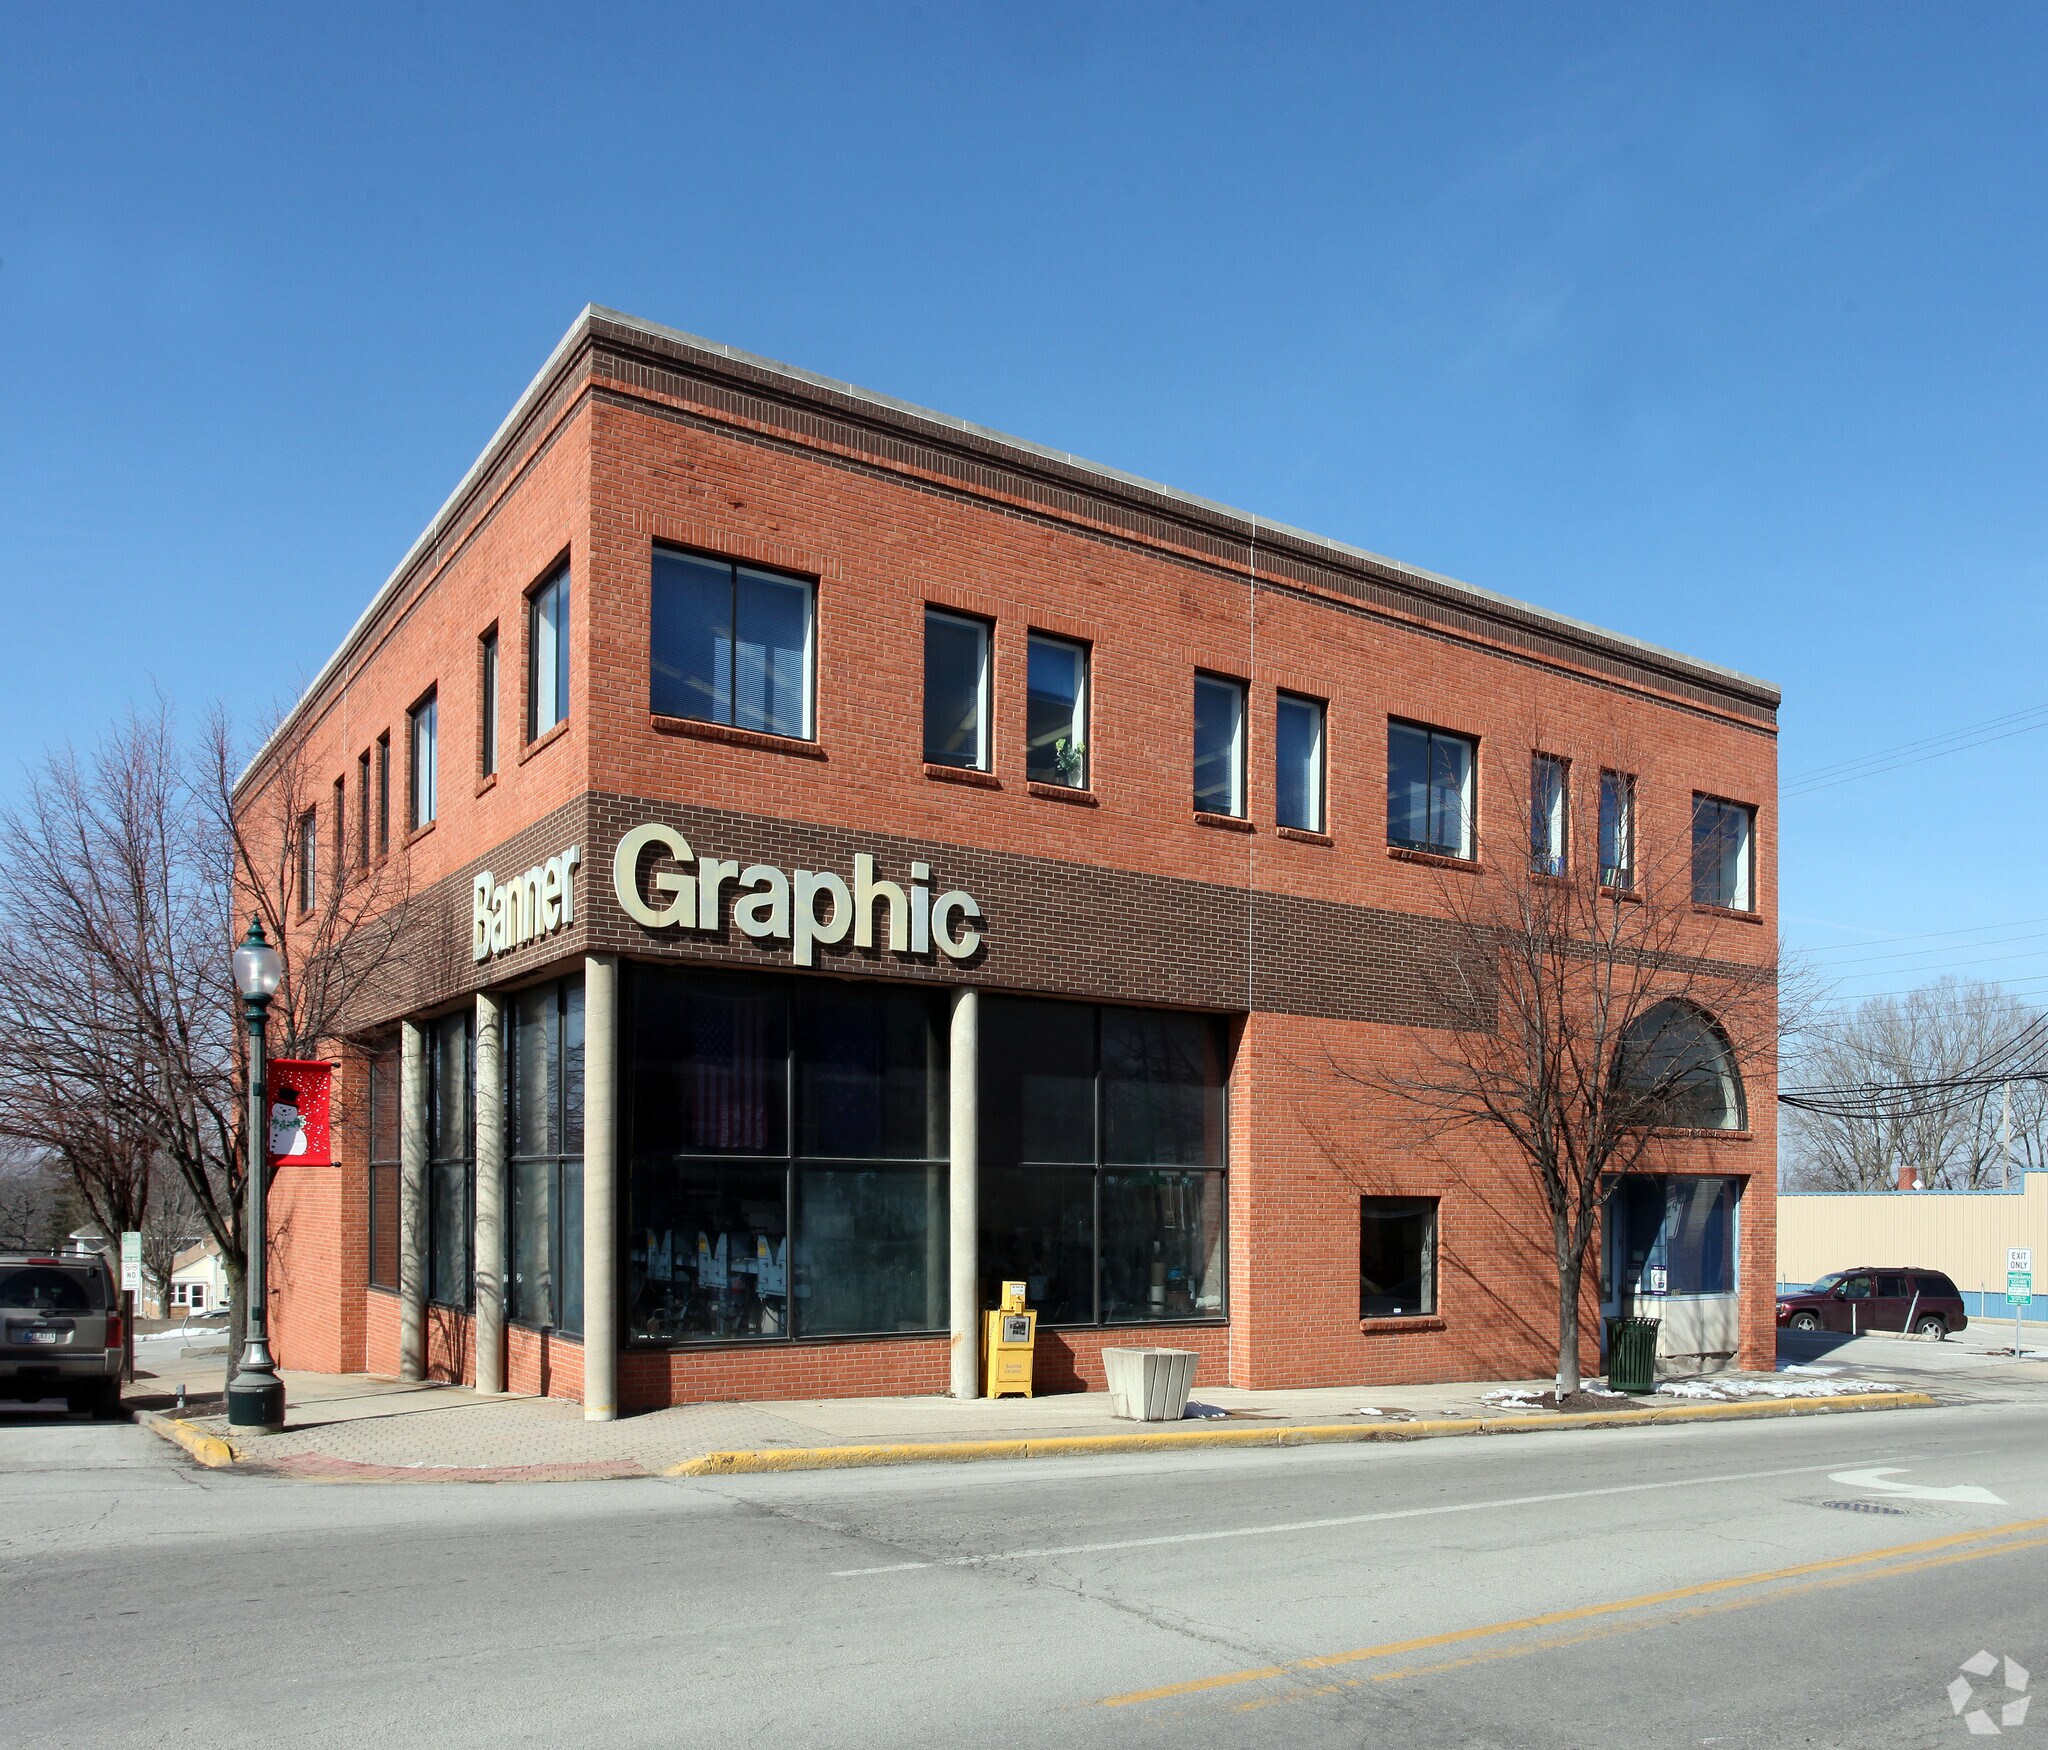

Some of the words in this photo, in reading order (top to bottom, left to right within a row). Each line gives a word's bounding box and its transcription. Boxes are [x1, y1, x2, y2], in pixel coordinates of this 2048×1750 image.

[472, 844, 580, 963] Banner
[613, 823, 981, 966] Graphic
[2010, 1261, 2028, 1269] ONLY
[2011, 1252, 2026, 1260] EXIT
